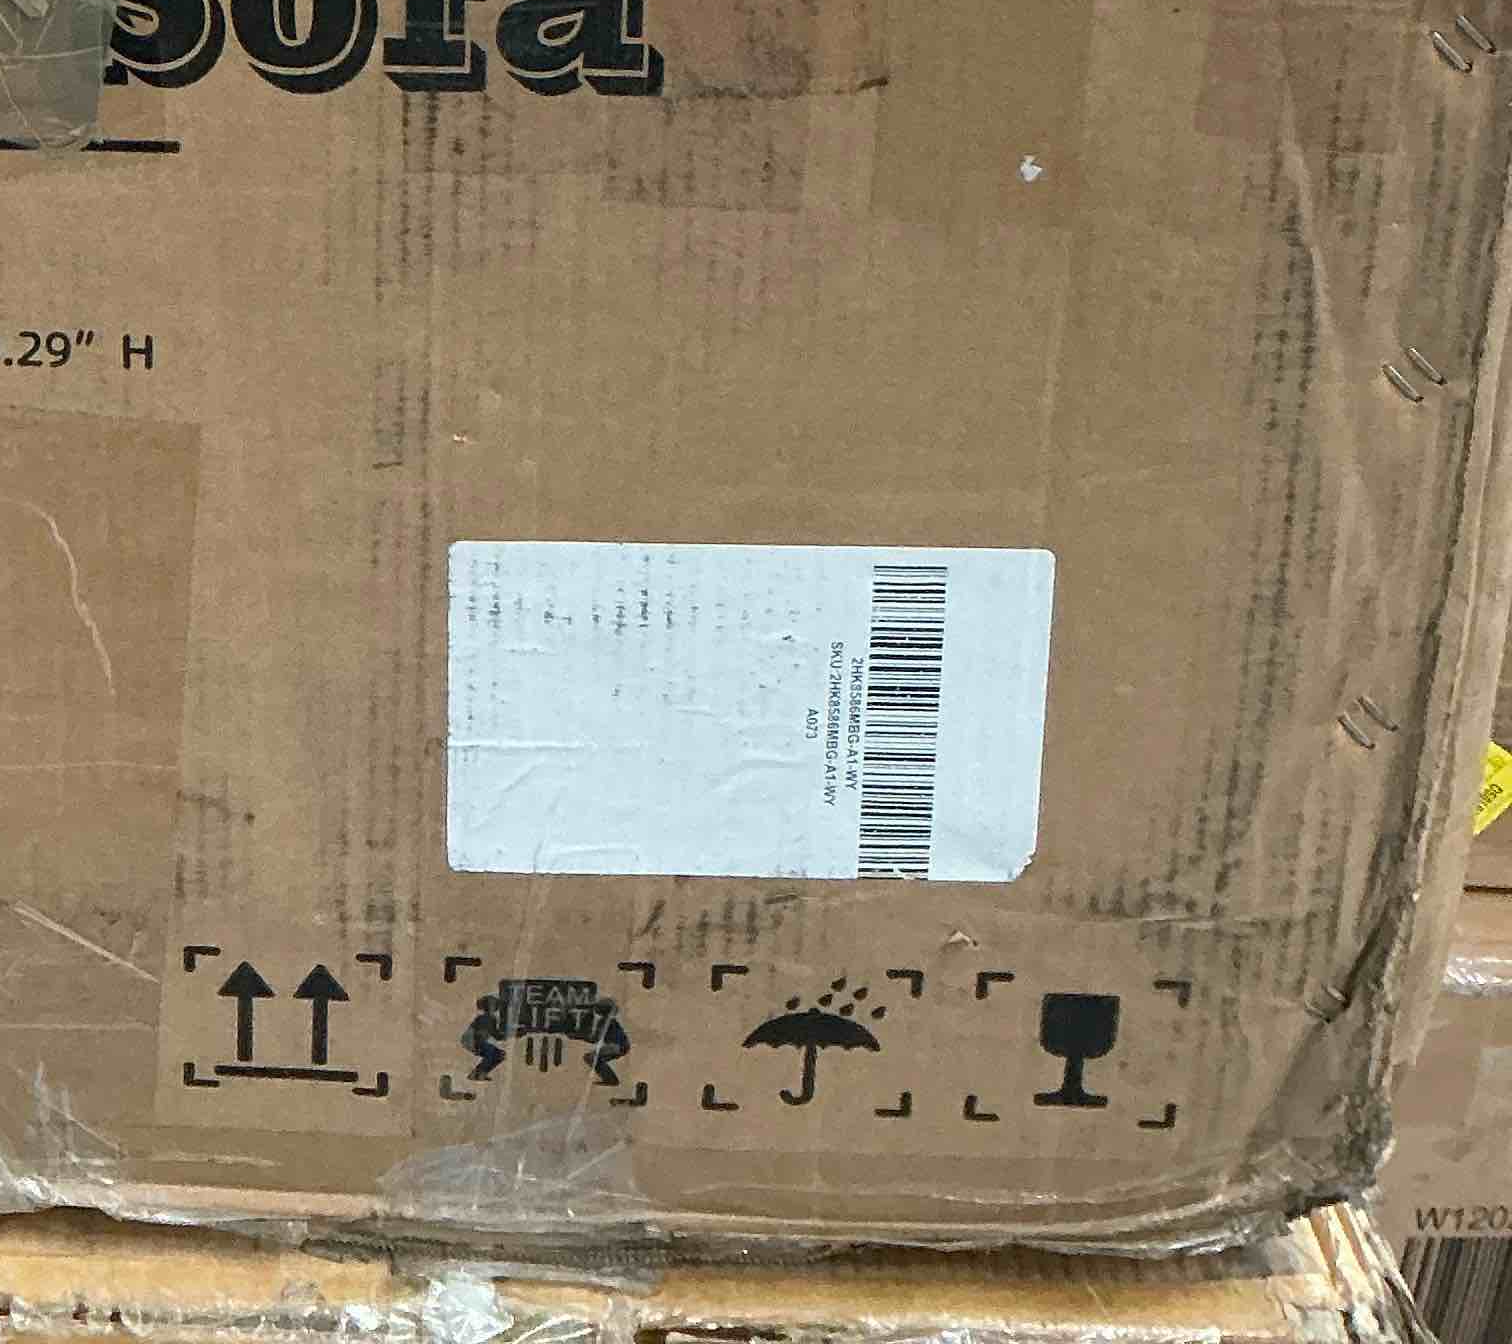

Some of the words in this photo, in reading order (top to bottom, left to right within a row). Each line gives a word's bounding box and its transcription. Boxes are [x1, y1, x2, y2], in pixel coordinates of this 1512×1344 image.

[121, 333, 154, 370] H
[805, 707, 820, 740] A073
[506, 984, 594, 1007] TEAM
[1414, 1204, 1512, 1231] W120
